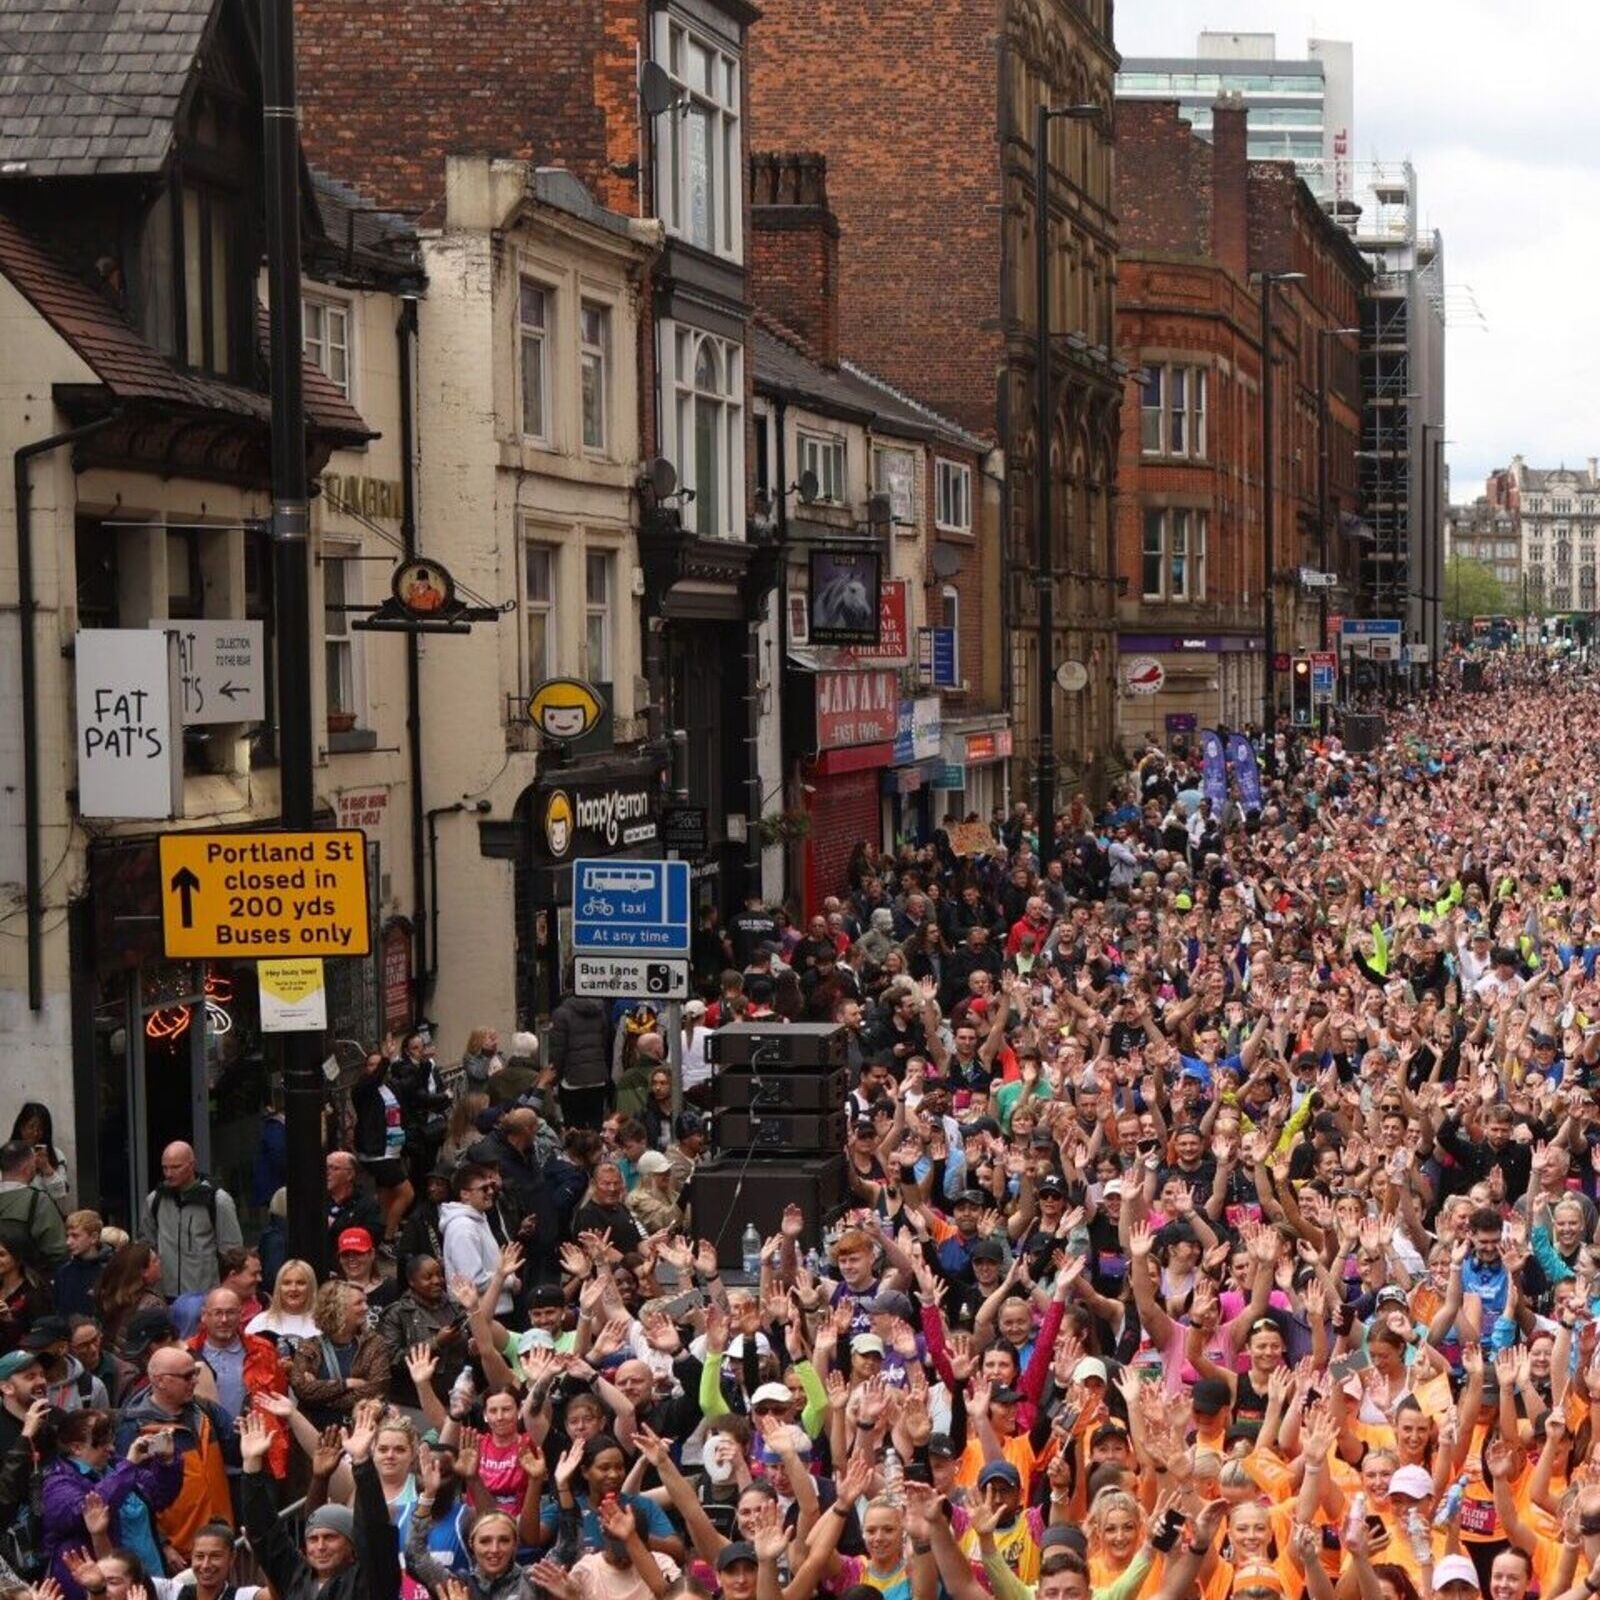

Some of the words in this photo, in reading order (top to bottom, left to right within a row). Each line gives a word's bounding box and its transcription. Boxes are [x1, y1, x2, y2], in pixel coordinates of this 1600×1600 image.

[849, 645, 903, 656] CHICKEN
[95, 689, 148, 724] FAT
[84, 725, 162, 759] PAT'S
[576, 792, 618, 846] happy
[207, 841, 314, 864] Portland
[325, 841, 353, 861] St
[224, 870, 305, 890] closed
[315, 869, 336, 888] in
[229, 896, 283, 917] 200
[293, 896, 335, 920] yds
[621, 902, 646, 913] taxi
[216, 925, 290, 944] Buses
[300, 923, 352, 946] only
[593, 930, 608, 941] At
[613, 932, 636, 944] any
[640, 930, 669, 942] time
[581, 963, 605, 975] Bus
[610, 964, 639, 976] lane
[581, 980, 637, 991] cameras
